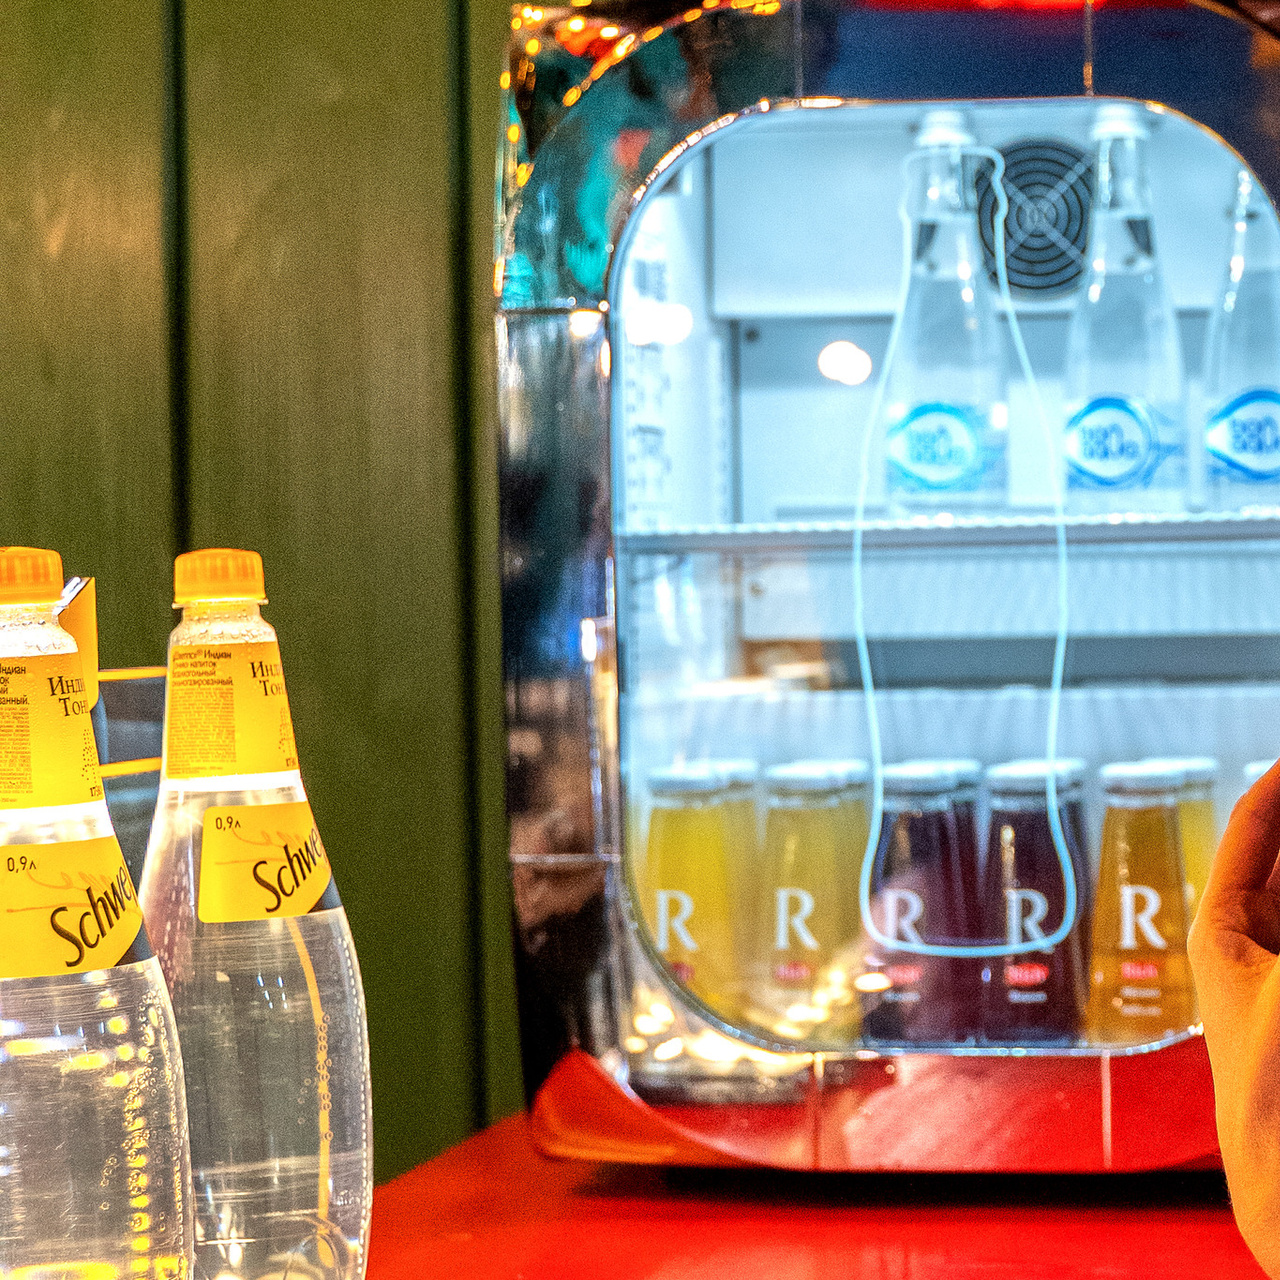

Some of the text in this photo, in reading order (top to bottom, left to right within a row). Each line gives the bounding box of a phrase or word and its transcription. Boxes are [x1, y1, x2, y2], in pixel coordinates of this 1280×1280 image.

[252, 828, 323, 913] Schwe
[50, 865, 135, 968] Schwe
[656, 888, 698, 953] R
[775, 887, 820, 951] R
[885, 888, 928, 949] R
[1007, 888, 1055, 952] R
[1119, 885, 1168, 950] R
